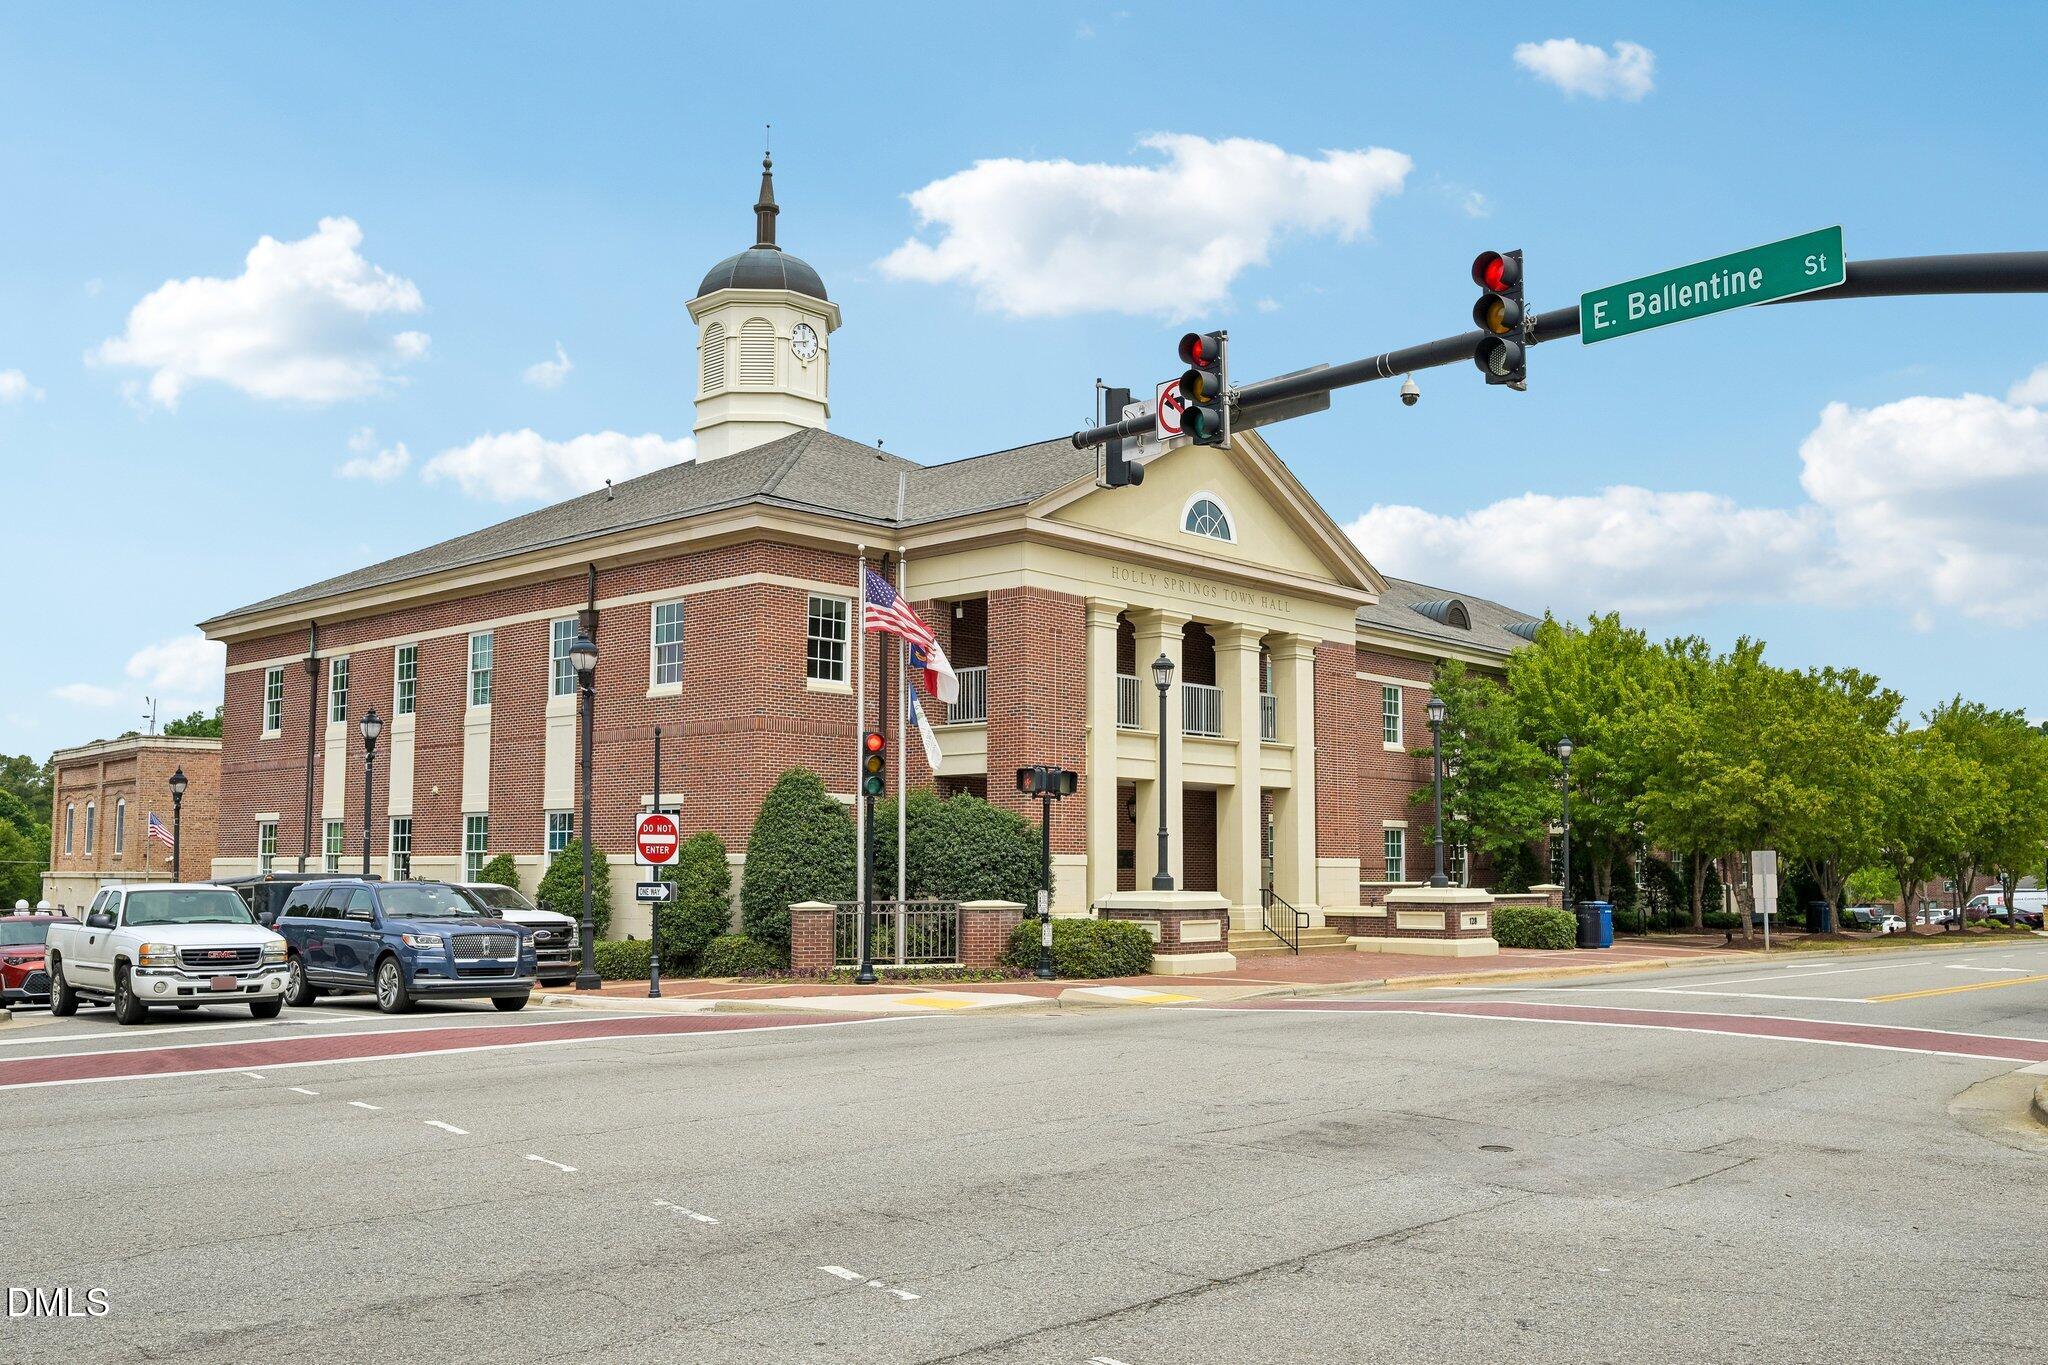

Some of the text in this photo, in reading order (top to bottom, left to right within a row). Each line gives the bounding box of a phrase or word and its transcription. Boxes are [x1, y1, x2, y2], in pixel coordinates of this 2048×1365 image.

[1593, 253, 1827, 330] E. Ballentine St
[1111, 566, 1291, 613] HOLLY SPRINGS TOWN HALL
[643, 824, 672, 833] DO NOT
[645, 845, 670, 854] ENTER
[639, 887, 661, 896] ONE WAY
[1469, 917, 1477, 925] 128
[207, 950, 237, 959] GMC
